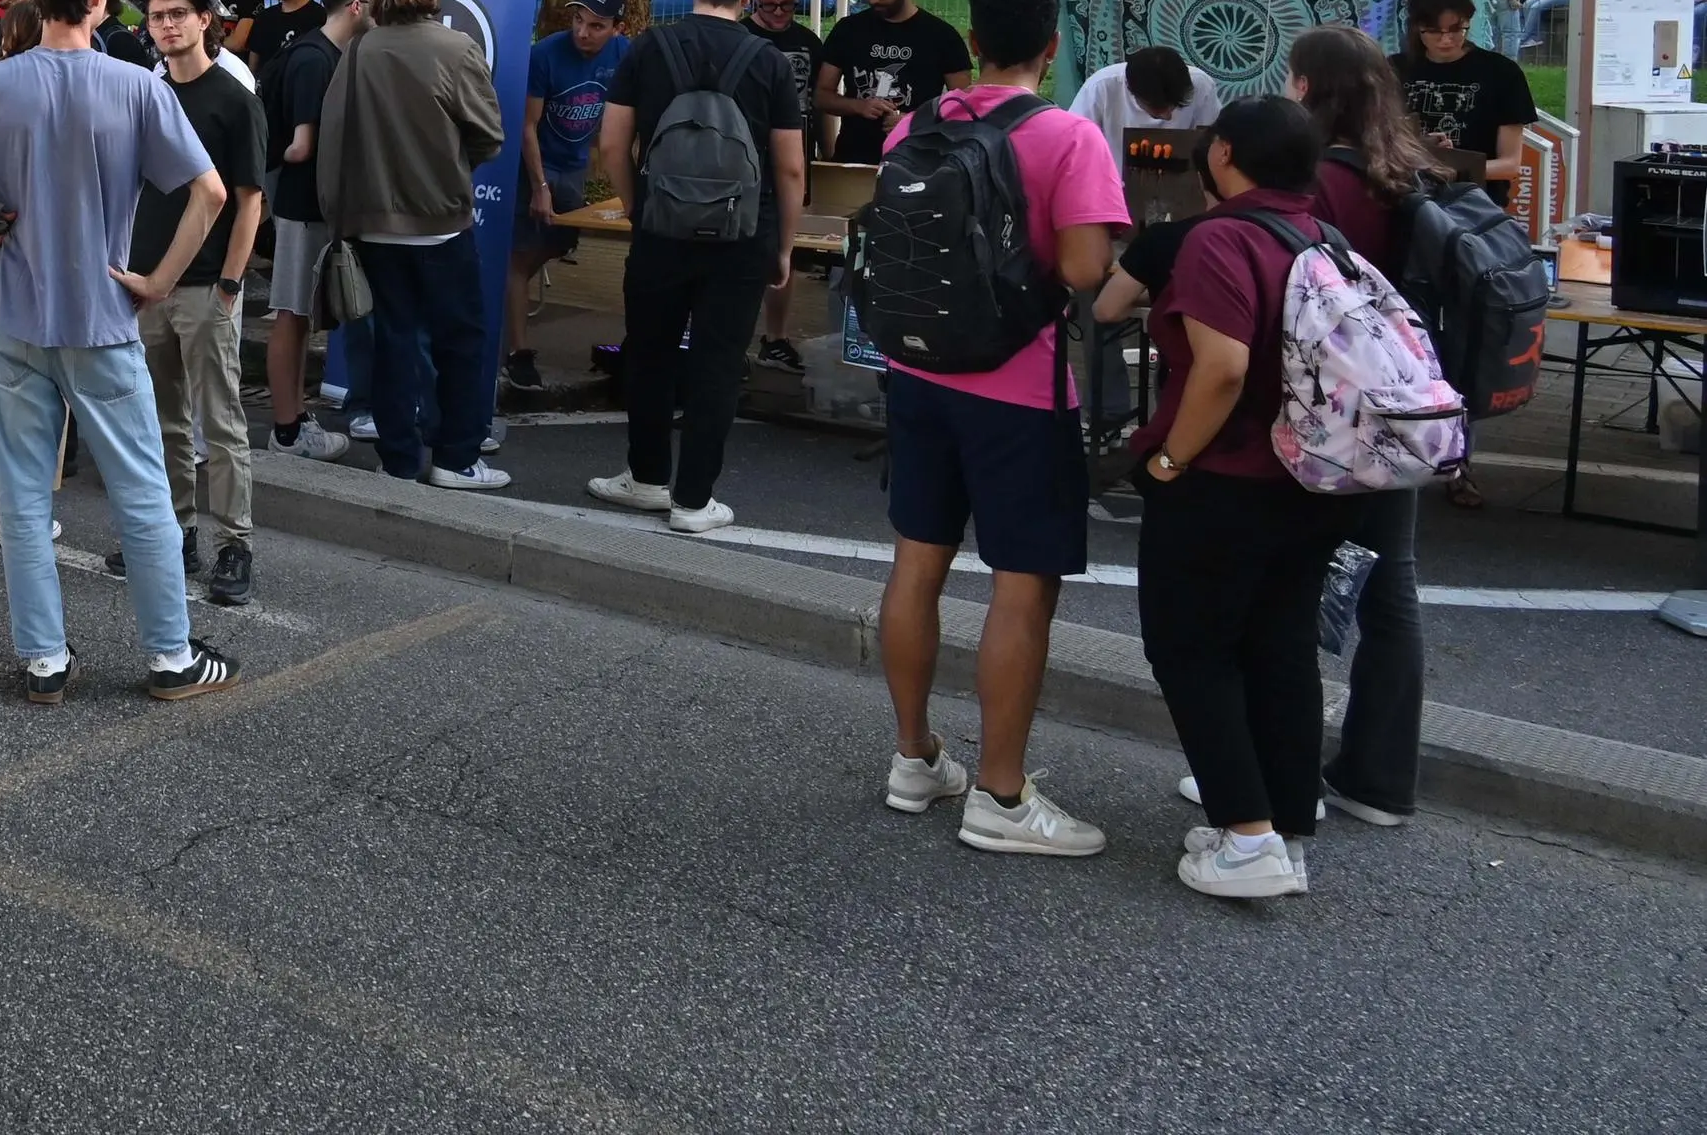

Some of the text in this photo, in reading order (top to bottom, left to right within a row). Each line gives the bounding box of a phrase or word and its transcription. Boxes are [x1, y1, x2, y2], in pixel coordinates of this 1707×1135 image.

[869, 43, 913, 60] SUDO
[547, 102, 605, 121] STREE
[1647, 167, 1707, 177] FLYING BEAR
[472, 183, 501, 202] CK:
